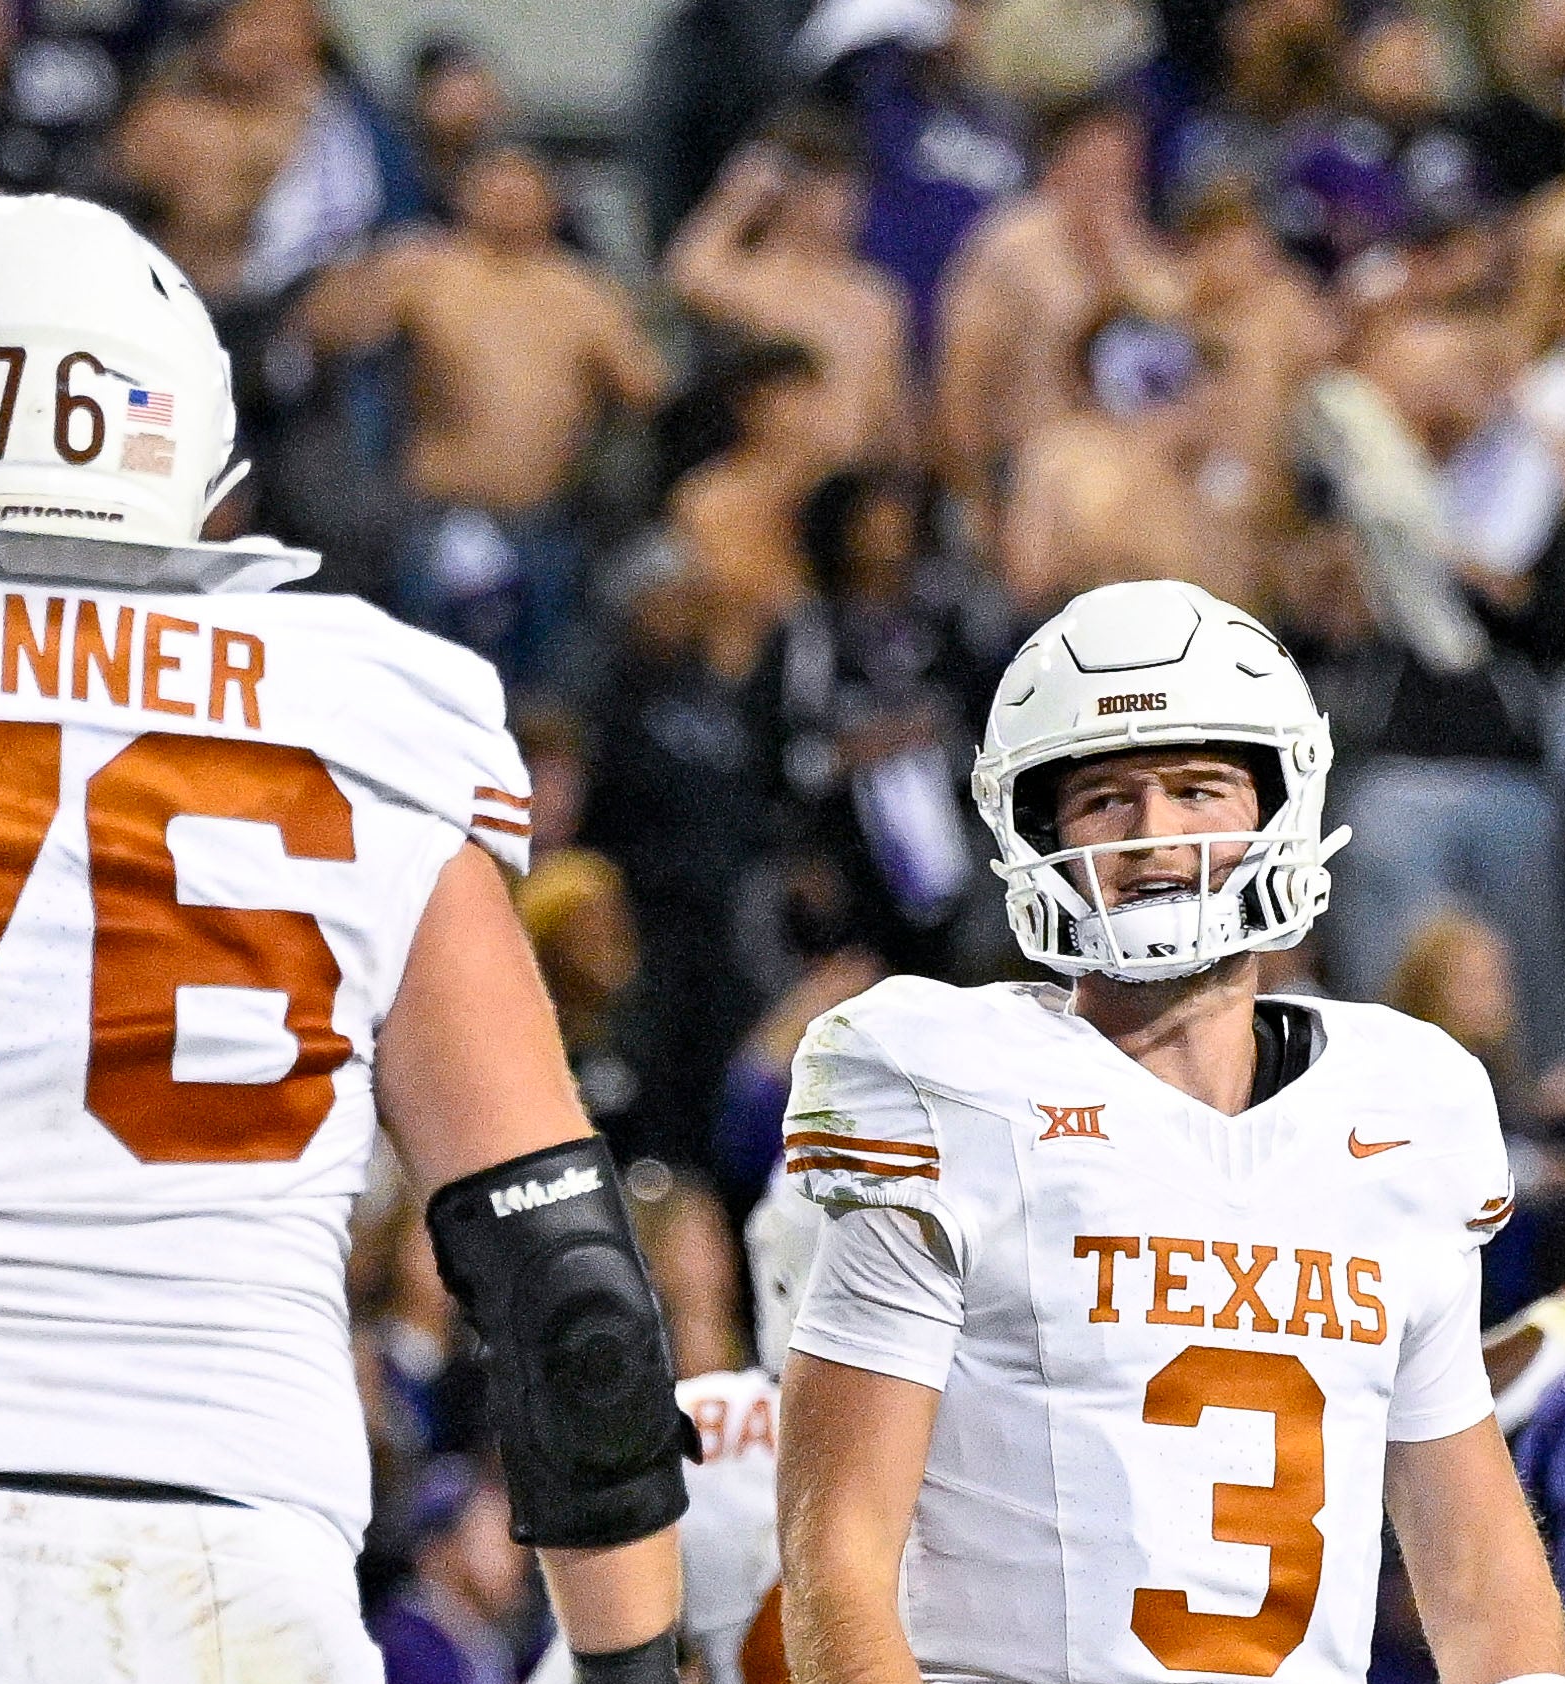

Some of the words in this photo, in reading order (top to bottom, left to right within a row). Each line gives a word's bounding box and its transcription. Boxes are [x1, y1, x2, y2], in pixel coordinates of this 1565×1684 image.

[1096, 692, 1167, 716] HORNS
[1035, 1103, 1110, 1141] XII
[1073, 1235, 1389, 1346] TEXAS
[1129, 1345, 1327, 1678] 3
